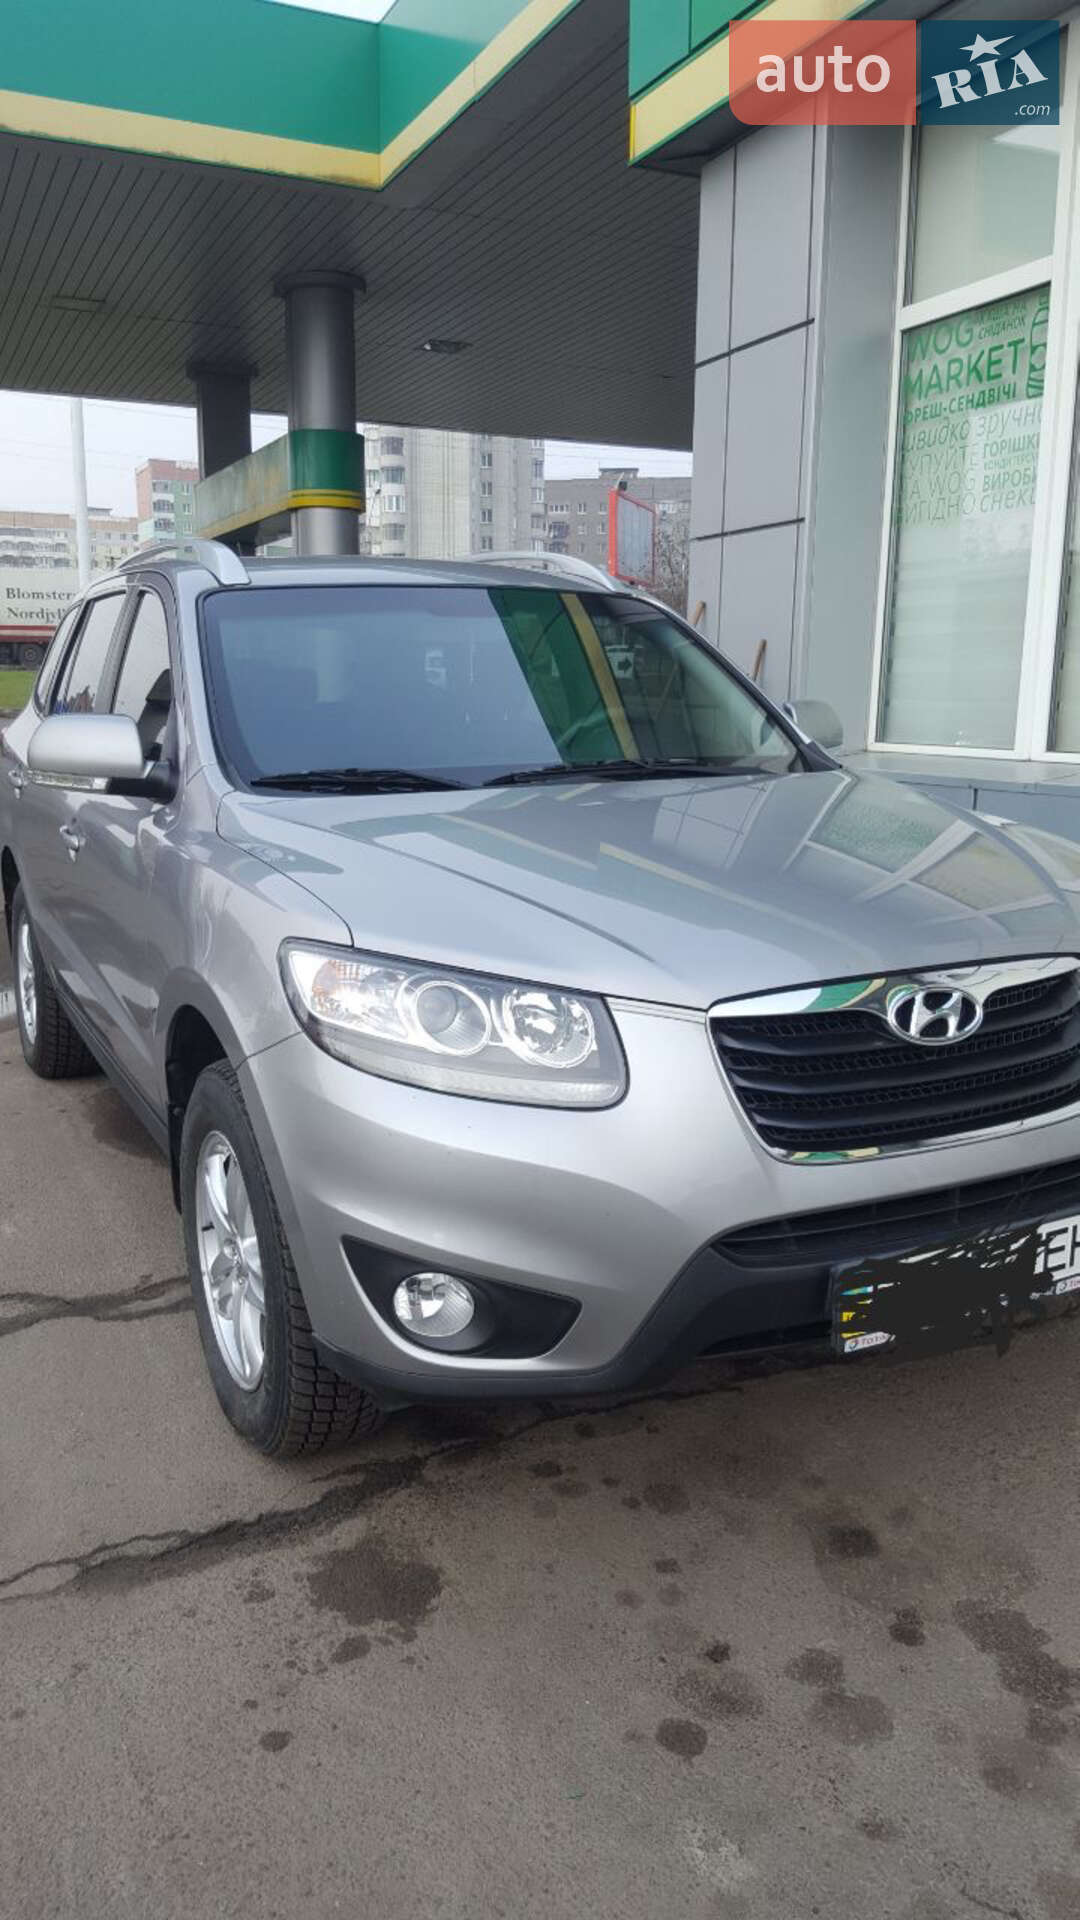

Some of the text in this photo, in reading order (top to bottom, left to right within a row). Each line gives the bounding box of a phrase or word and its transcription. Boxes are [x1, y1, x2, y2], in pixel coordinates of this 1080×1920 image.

[908, 318, 974, 362] WOG
[904, 337, 1026, 401] MARKET
[904, 443, 979, 478] УПУЙТЕ
[901, 492, 976, 524] ИГІДНО
